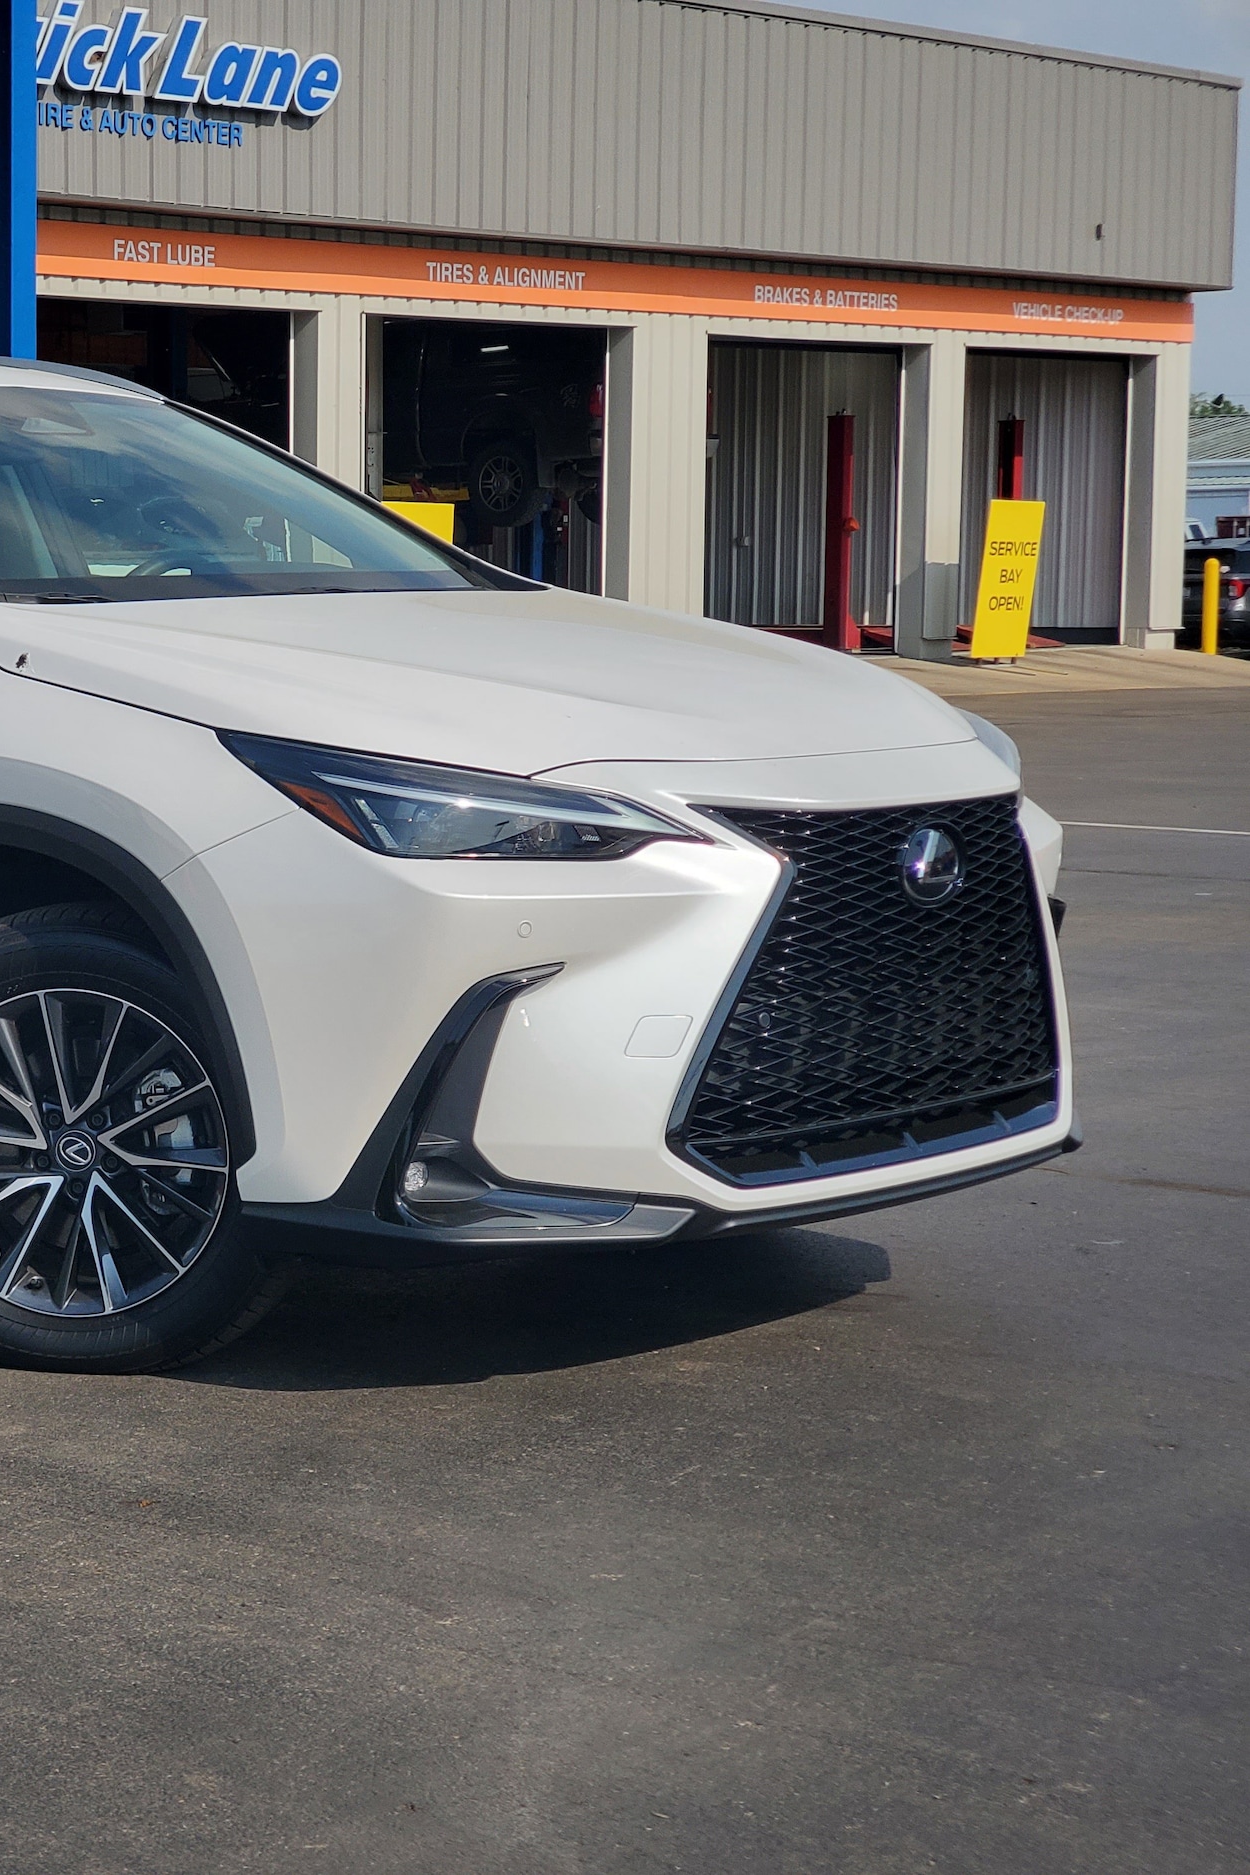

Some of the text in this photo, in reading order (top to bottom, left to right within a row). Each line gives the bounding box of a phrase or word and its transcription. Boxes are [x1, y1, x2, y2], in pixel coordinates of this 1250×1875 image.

[153, 14, 342, 117] Lane
[37, 101, 244, 147] IRE & AUTO CENTER
[114, 239, 216, 267] FAST LUBE
[426, 261, 586, 291] TIRES & ALIGNMENT
[754, 285, 898, 312] BRAKES & BATTERIES
[1012, 302, 1125, 325] VEHICLE CHECK-UP
[989, 541, 1038, 557] SERVICE
[999, 569, 1023, 584] BAY
[988, 596, 1024, 611] OPEN!
